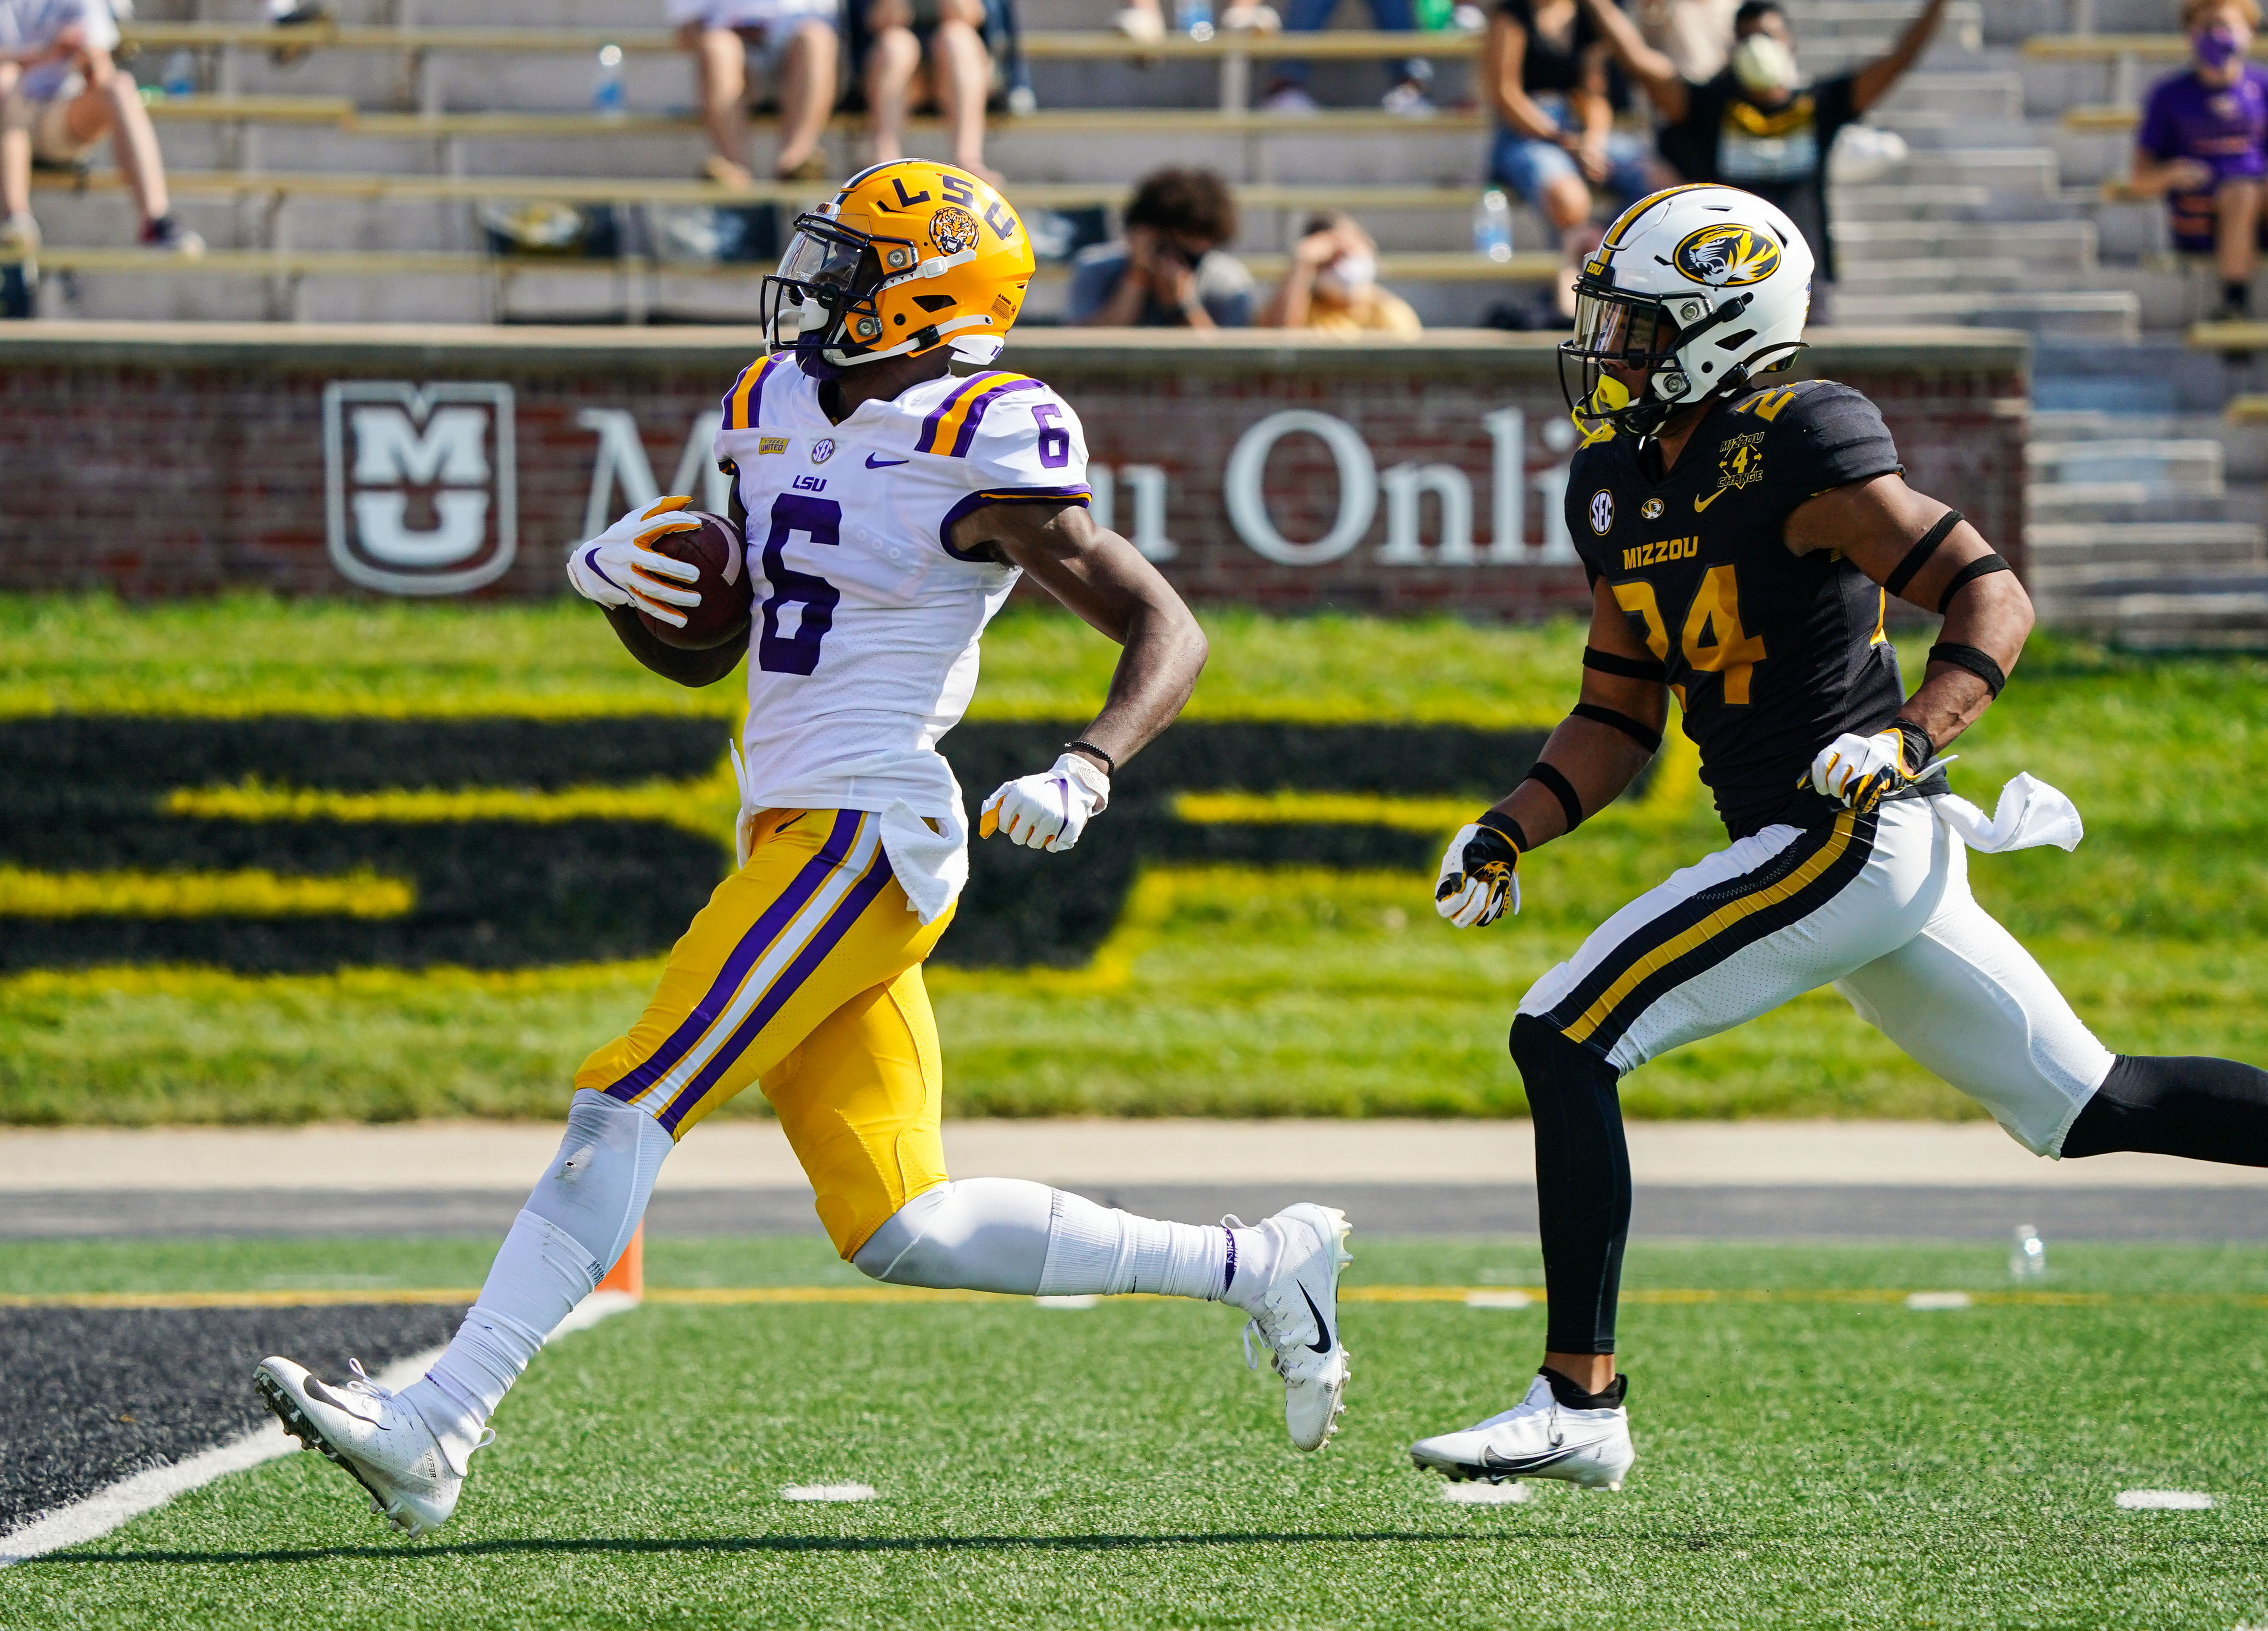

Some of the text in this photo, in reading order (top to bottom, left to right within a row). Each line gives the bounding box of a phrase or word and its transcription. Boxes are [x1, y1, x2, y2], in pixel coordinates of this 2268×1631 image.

[1586, 262, 1605, 275] ZOU
[1736, 382, 1807, 422] 2
[1031, 404, 1069, 469] 6
[1720, 432, 1765, 452] MIZZOU
[813, 440, 834, 462] SEC
[1732, 447, 1748, 473] 4
[793, 475, 827, 492] LSU
[1717, 470, 1763, 487] CHANGE
[1592, 493, 1612, 532] SEC
[1623, 536, 1698, 570] MIZZOU
[759, 493, 842, 676] 6
